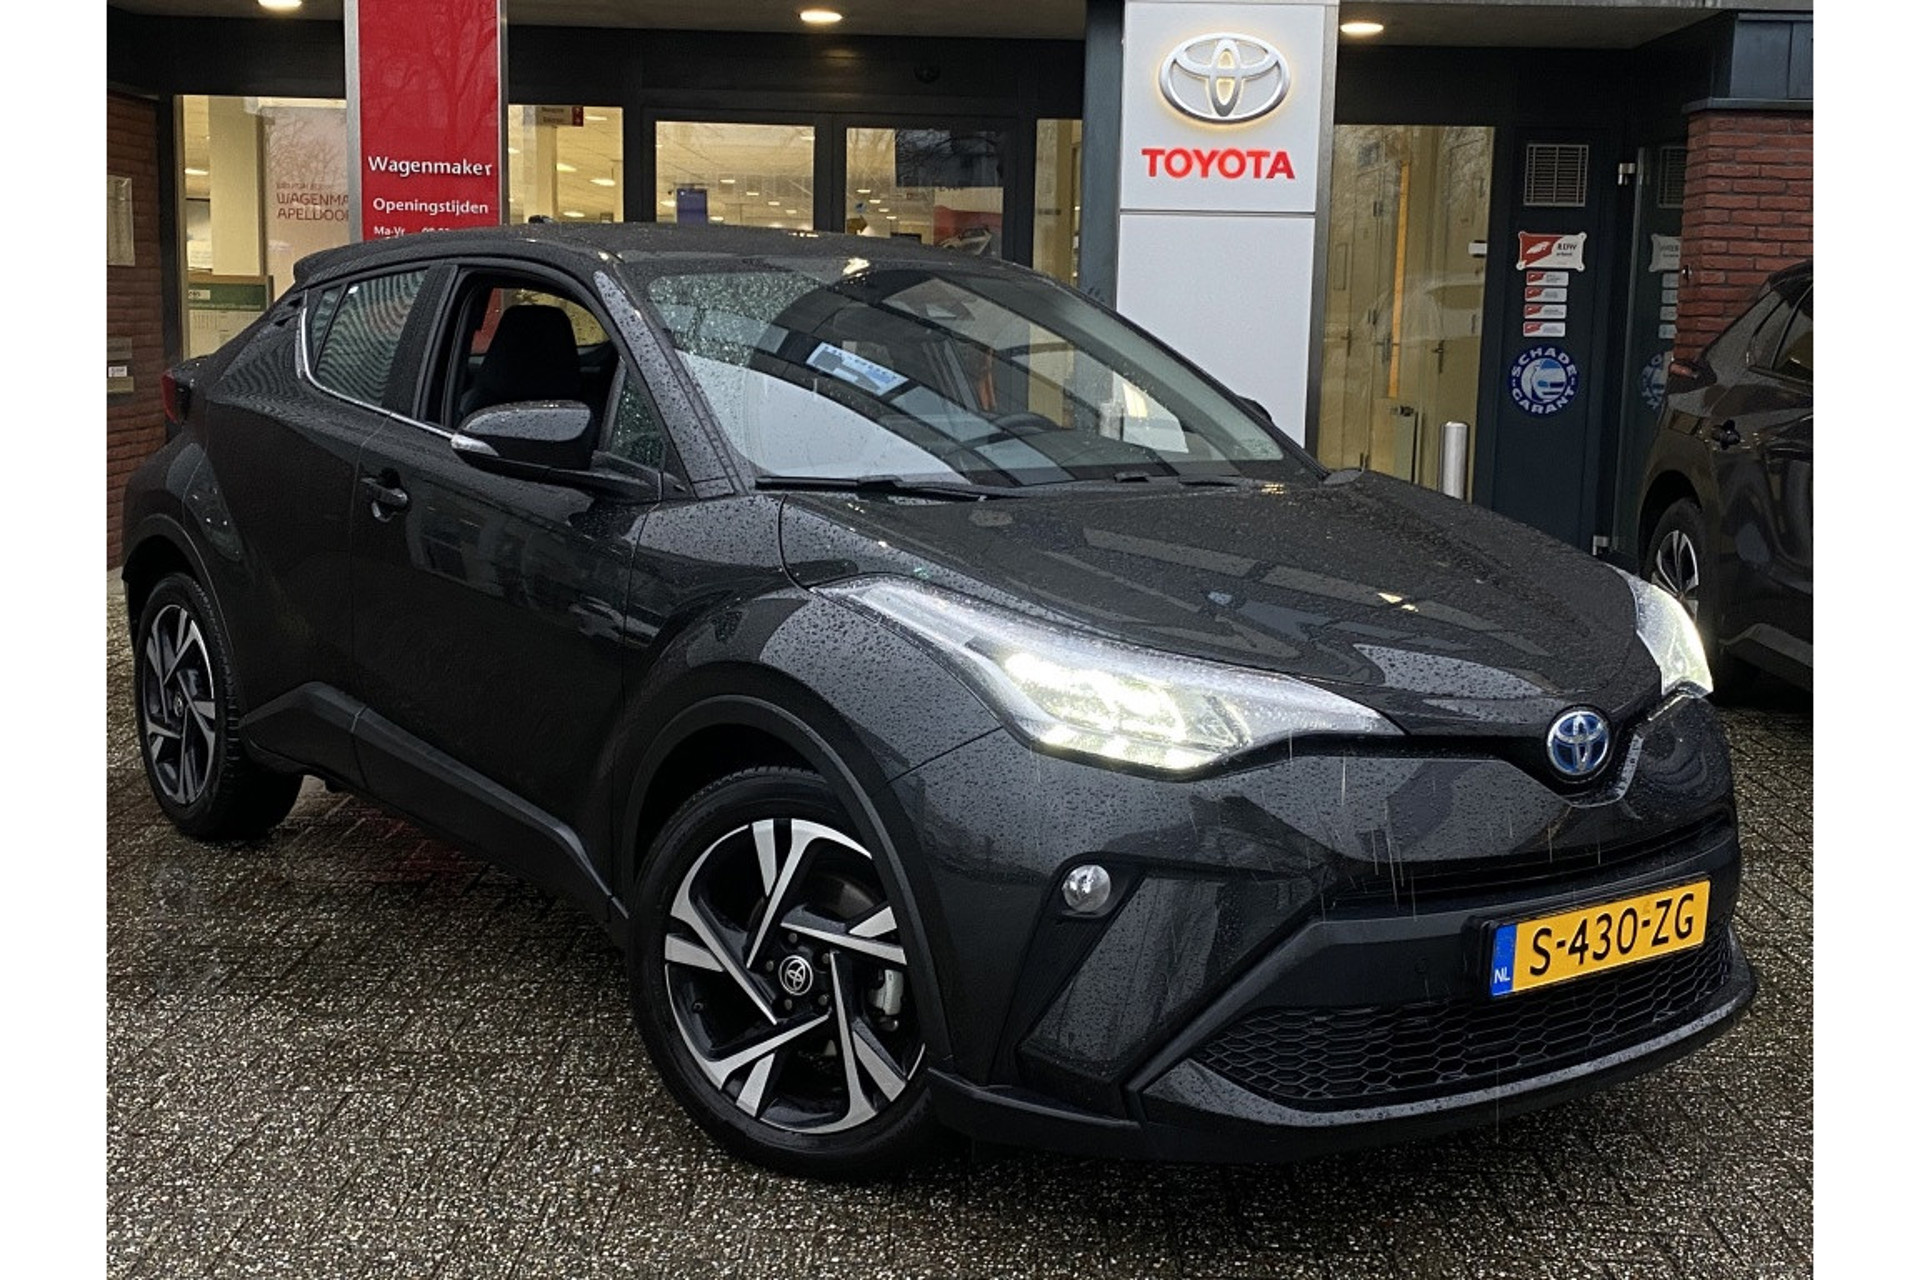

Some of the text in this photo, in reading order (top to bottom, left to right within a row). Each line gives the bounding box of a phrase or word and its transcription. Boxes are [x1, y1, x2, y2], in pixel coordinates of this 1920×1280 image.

[367, 155, 493, 178] Wagenmaker
[1141, 147, 1295, 179] TOYOTA
[373, 197, 489, 216] Openingstijden
[1511, 347, 1577, 377] SCHADE
[1512, 386, 1574, 414] GARANT
[1529, 893, 1694, 977] S-430-ZG
[1494, 966, 1511, 984] NL
